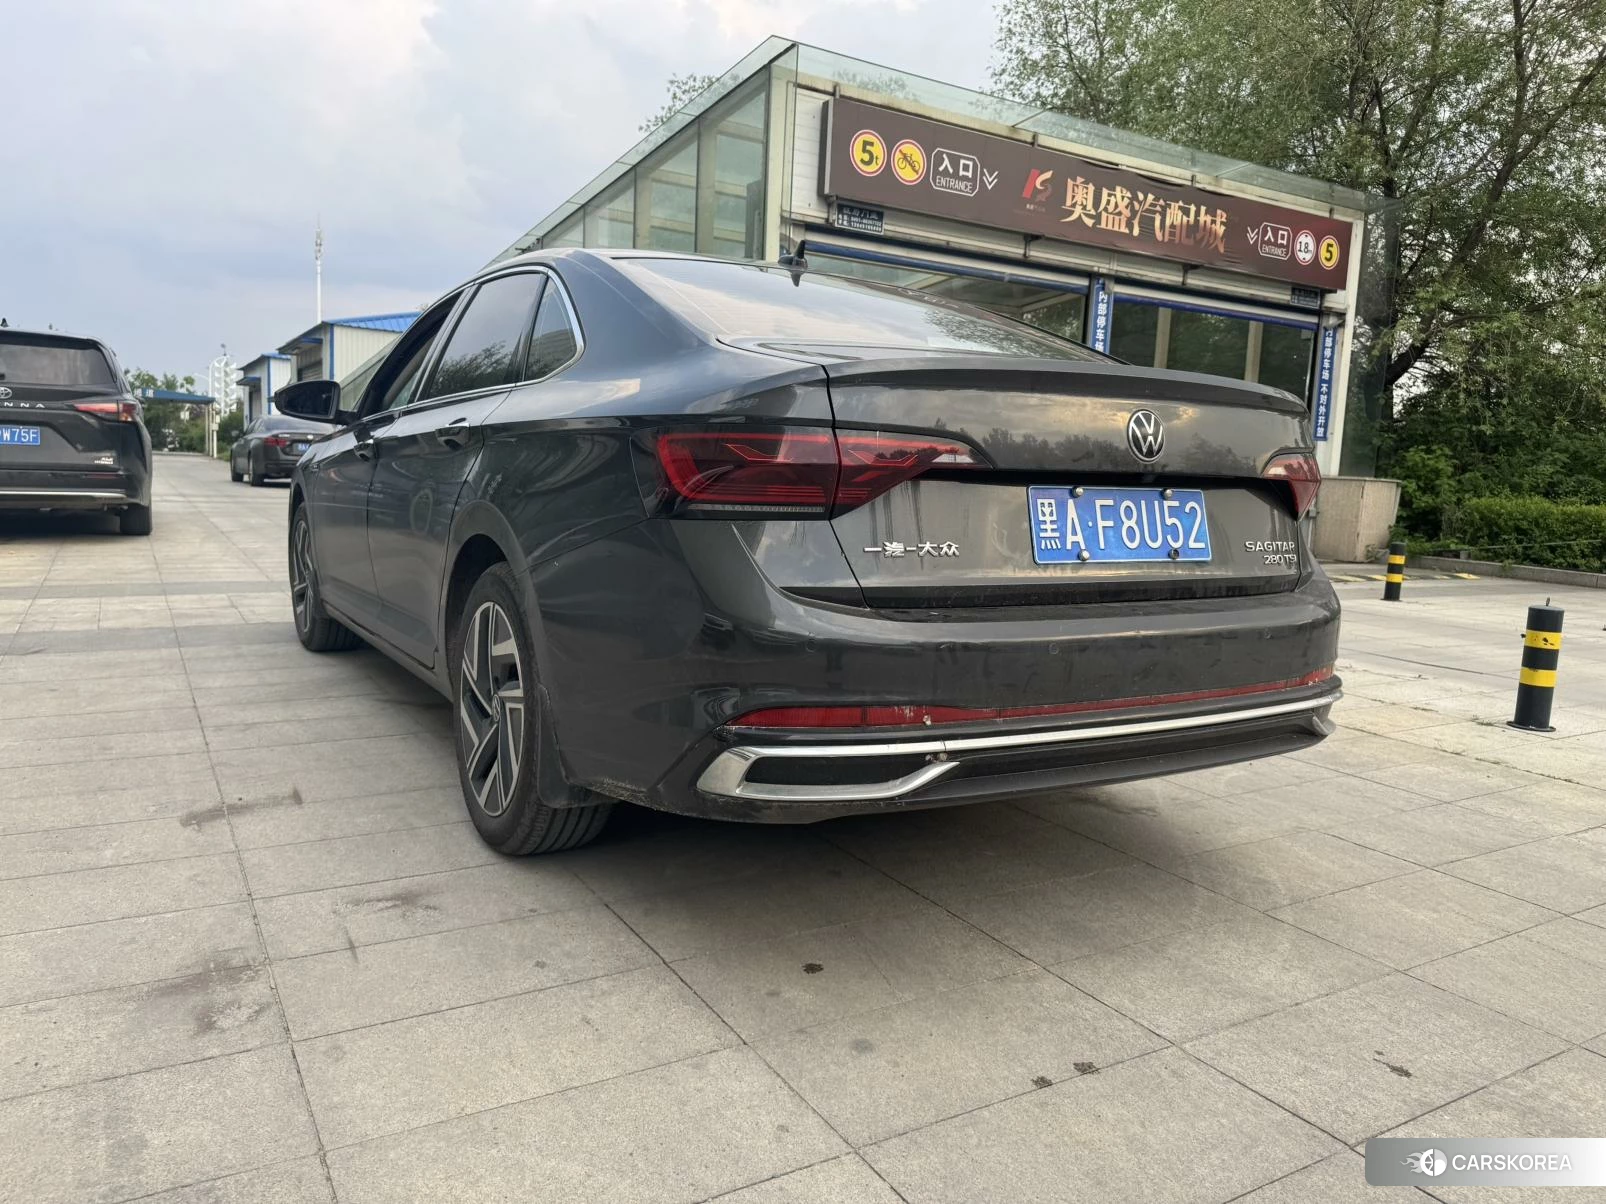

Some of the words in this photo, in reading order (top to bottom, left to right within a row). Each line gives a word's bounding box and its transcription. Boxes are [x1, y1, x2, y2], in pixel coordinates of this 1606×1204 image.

[938, 153, 973, 178] 入口
[935, 175, 973, 193] ENTRANCE
[1060, 175, 1228, 254] 奥盛汽配城
[1264, 226, 1288, 246] 入口
[1261, 243, 1287, 257] ENTRANCE
[1095, 291, 1108, 353] 内部停车场
[1321, 328, 1333, 380] 内部停车场
[1316, 383, 1328, 437] 不对外开放
[0, 428, 37, 442] W75F
[1245, 541, 1295, 552] SAGITAR
[1263, 554, 1283, 565] 280
